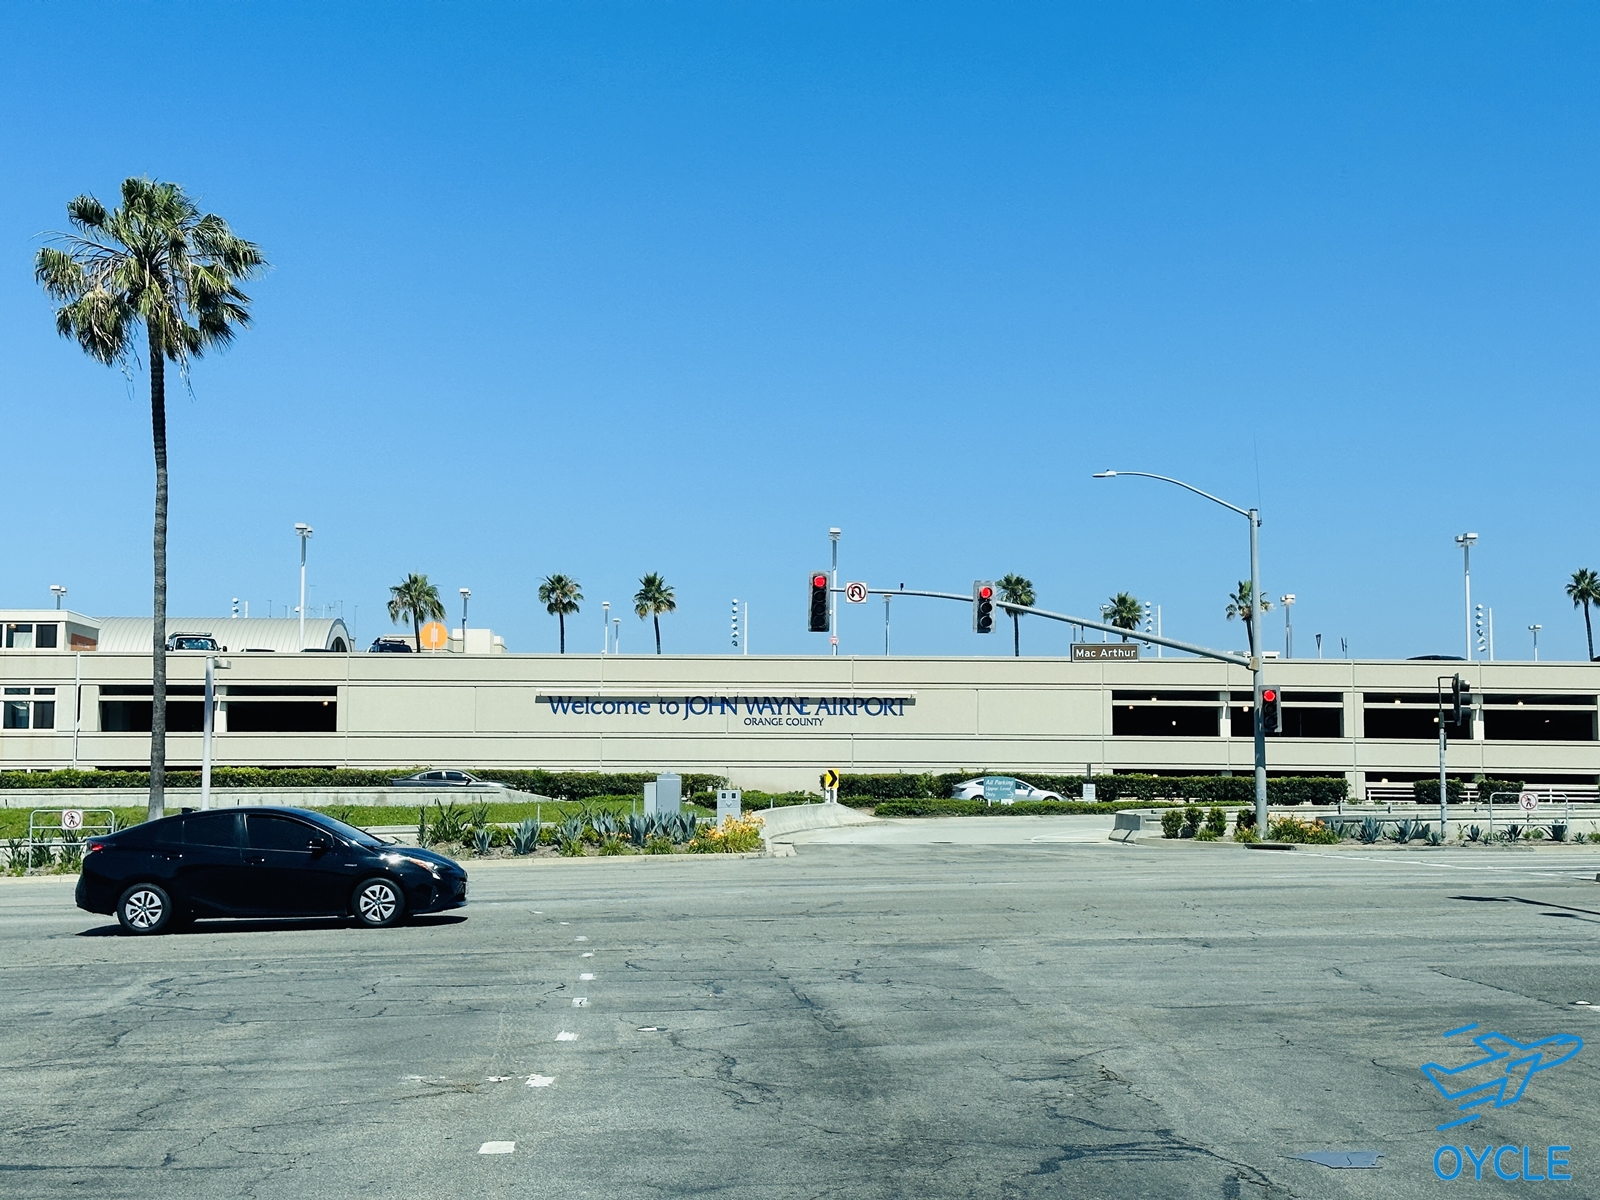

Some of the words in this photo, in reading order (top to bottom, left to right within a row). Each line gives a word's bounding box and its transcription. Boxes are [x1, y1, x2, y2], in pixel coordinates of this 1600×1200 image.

[1076, 649, 1096, 657] Mac
[1100, 648, 1136, 657] Arthur
[547, 696, 651, 715] Welcome
[658, 697, 680, 715] to
[682, 695, 738, 721] JOHN
[743, 696, 811, 716] WAYNE
[814, 696, 909, 716] AIRPORT
[743, 717, 783, 726] ORANGE
[785, 717, 824, 727] COUNTY
